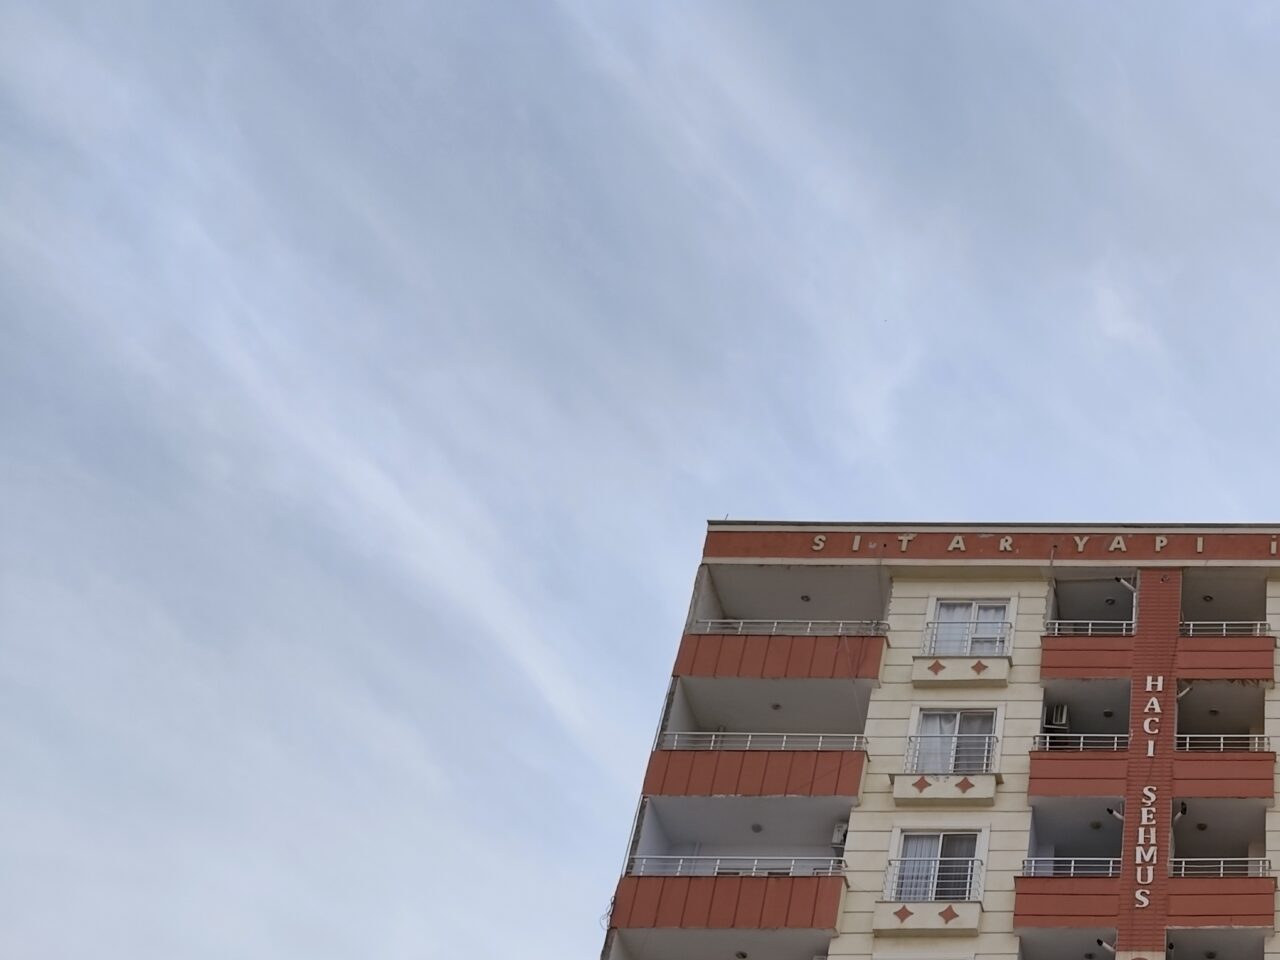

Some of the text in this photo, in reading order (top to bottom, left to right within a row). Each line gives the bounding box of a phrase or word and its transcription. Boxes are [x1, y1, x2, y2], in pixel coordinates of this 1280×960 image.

[1074, 536, 1204, 552] YAPI
[1143, 675, 1164, 757] HACI
[1135, 785, 1158, 908] ŞEHMUS
